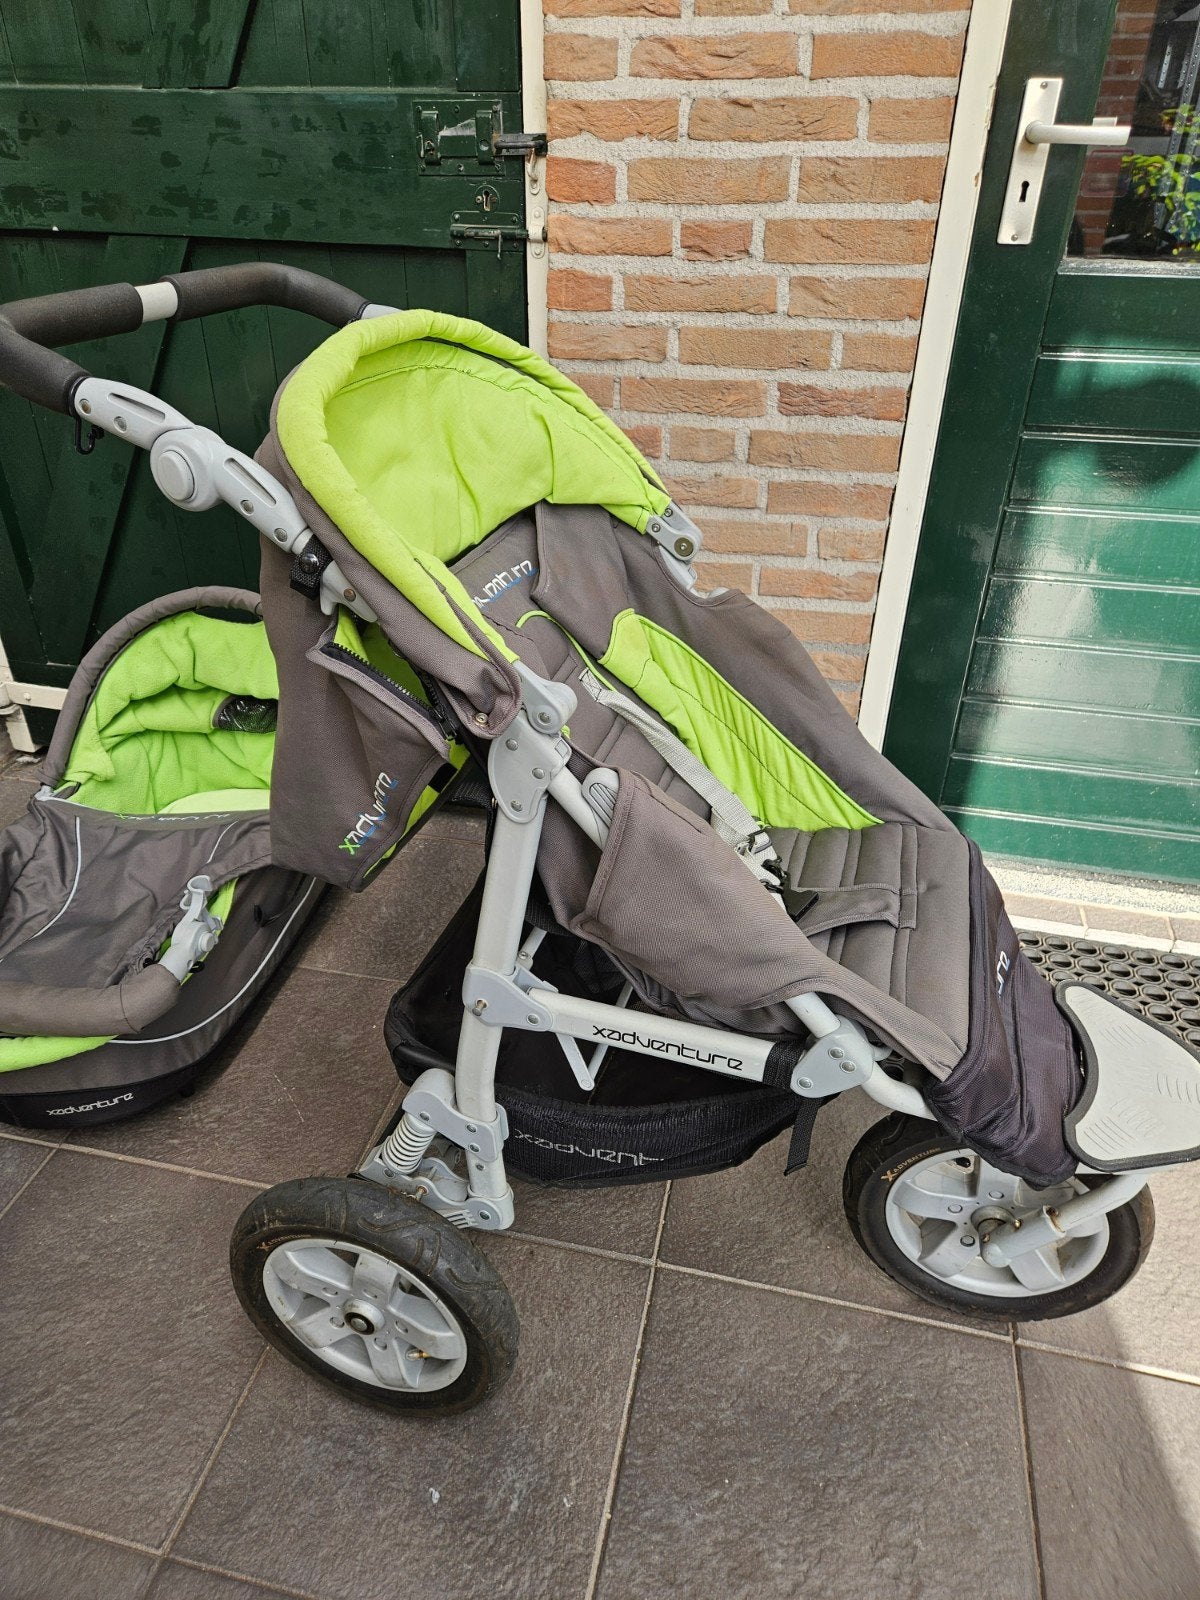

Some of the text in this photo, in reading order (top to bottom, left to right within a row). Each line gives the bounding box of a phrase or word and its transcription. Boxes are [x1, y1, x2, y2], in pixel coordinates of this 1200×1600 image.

[592, 1025, 743, 1071] xadventure
[46, 1092, 134, 1116] xadventure
[514, 1128, 664, 1167] xadvent
